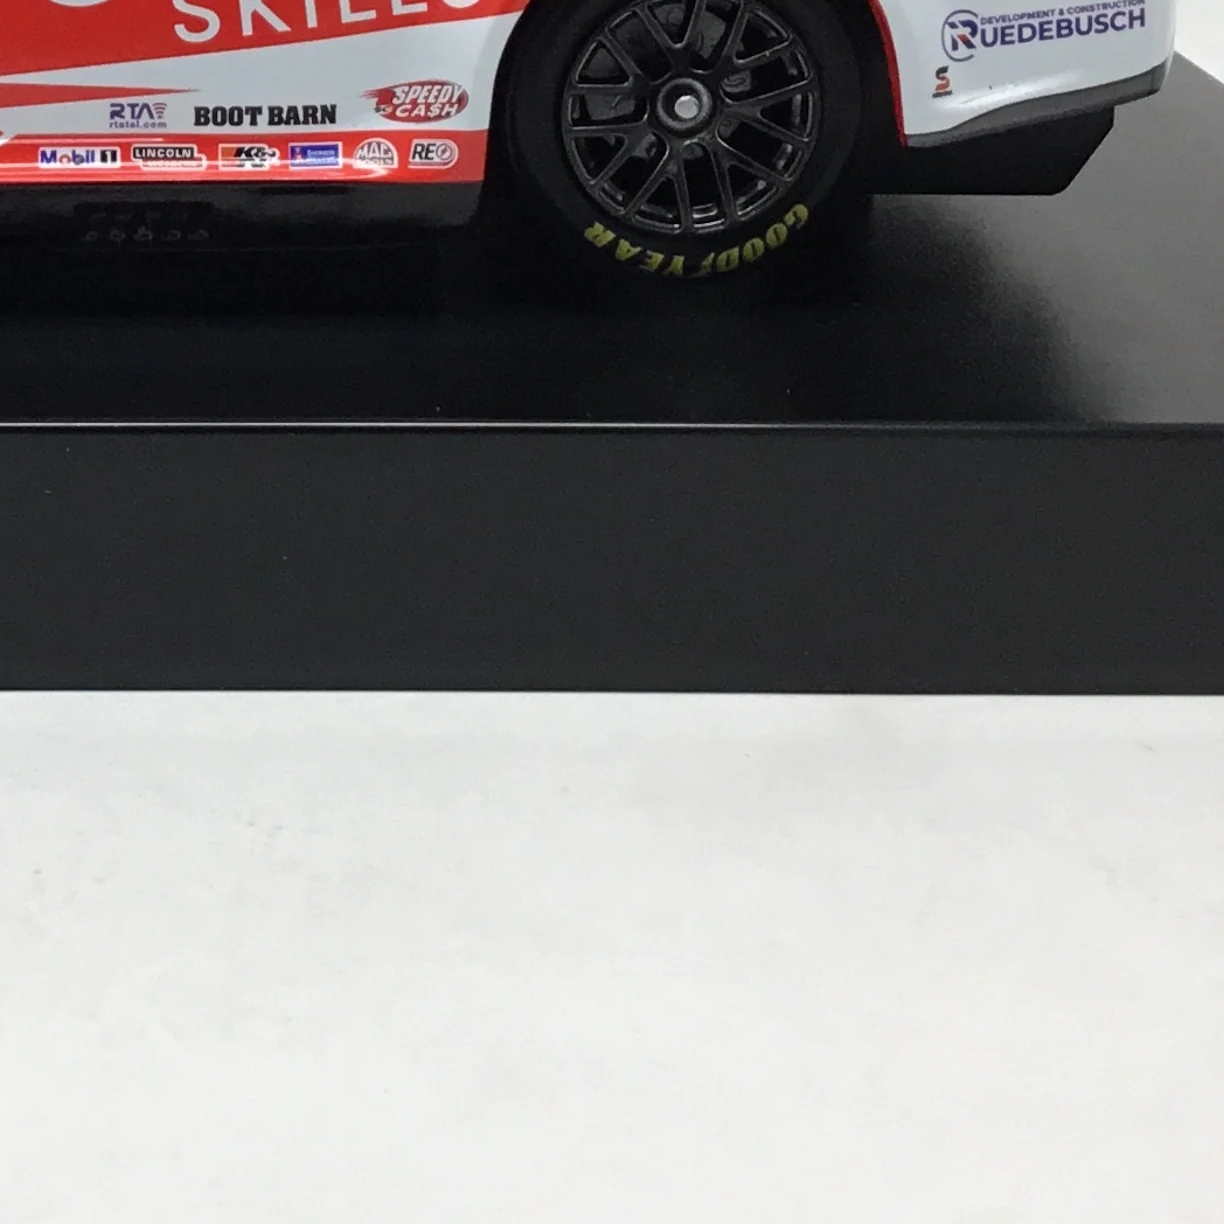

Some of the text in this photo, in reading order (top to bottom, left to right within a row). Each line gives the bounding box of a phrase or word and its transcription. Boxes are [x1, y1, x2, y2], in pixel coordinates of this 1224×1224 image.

[980, 8, 1056, 26] DEVELOPMENT
[392, 84, 465, 105] SPEEDY
[109, 102, 155, 120] RTA
[193, 104, 338, 127] BOOT BARN
[40, 150, 96, 166] Mobil
[135, 148, 192, 158] LINCOLN
[356, 141, 393, 159] MAC
[583, 203, 810, 276] GOODYEAR
